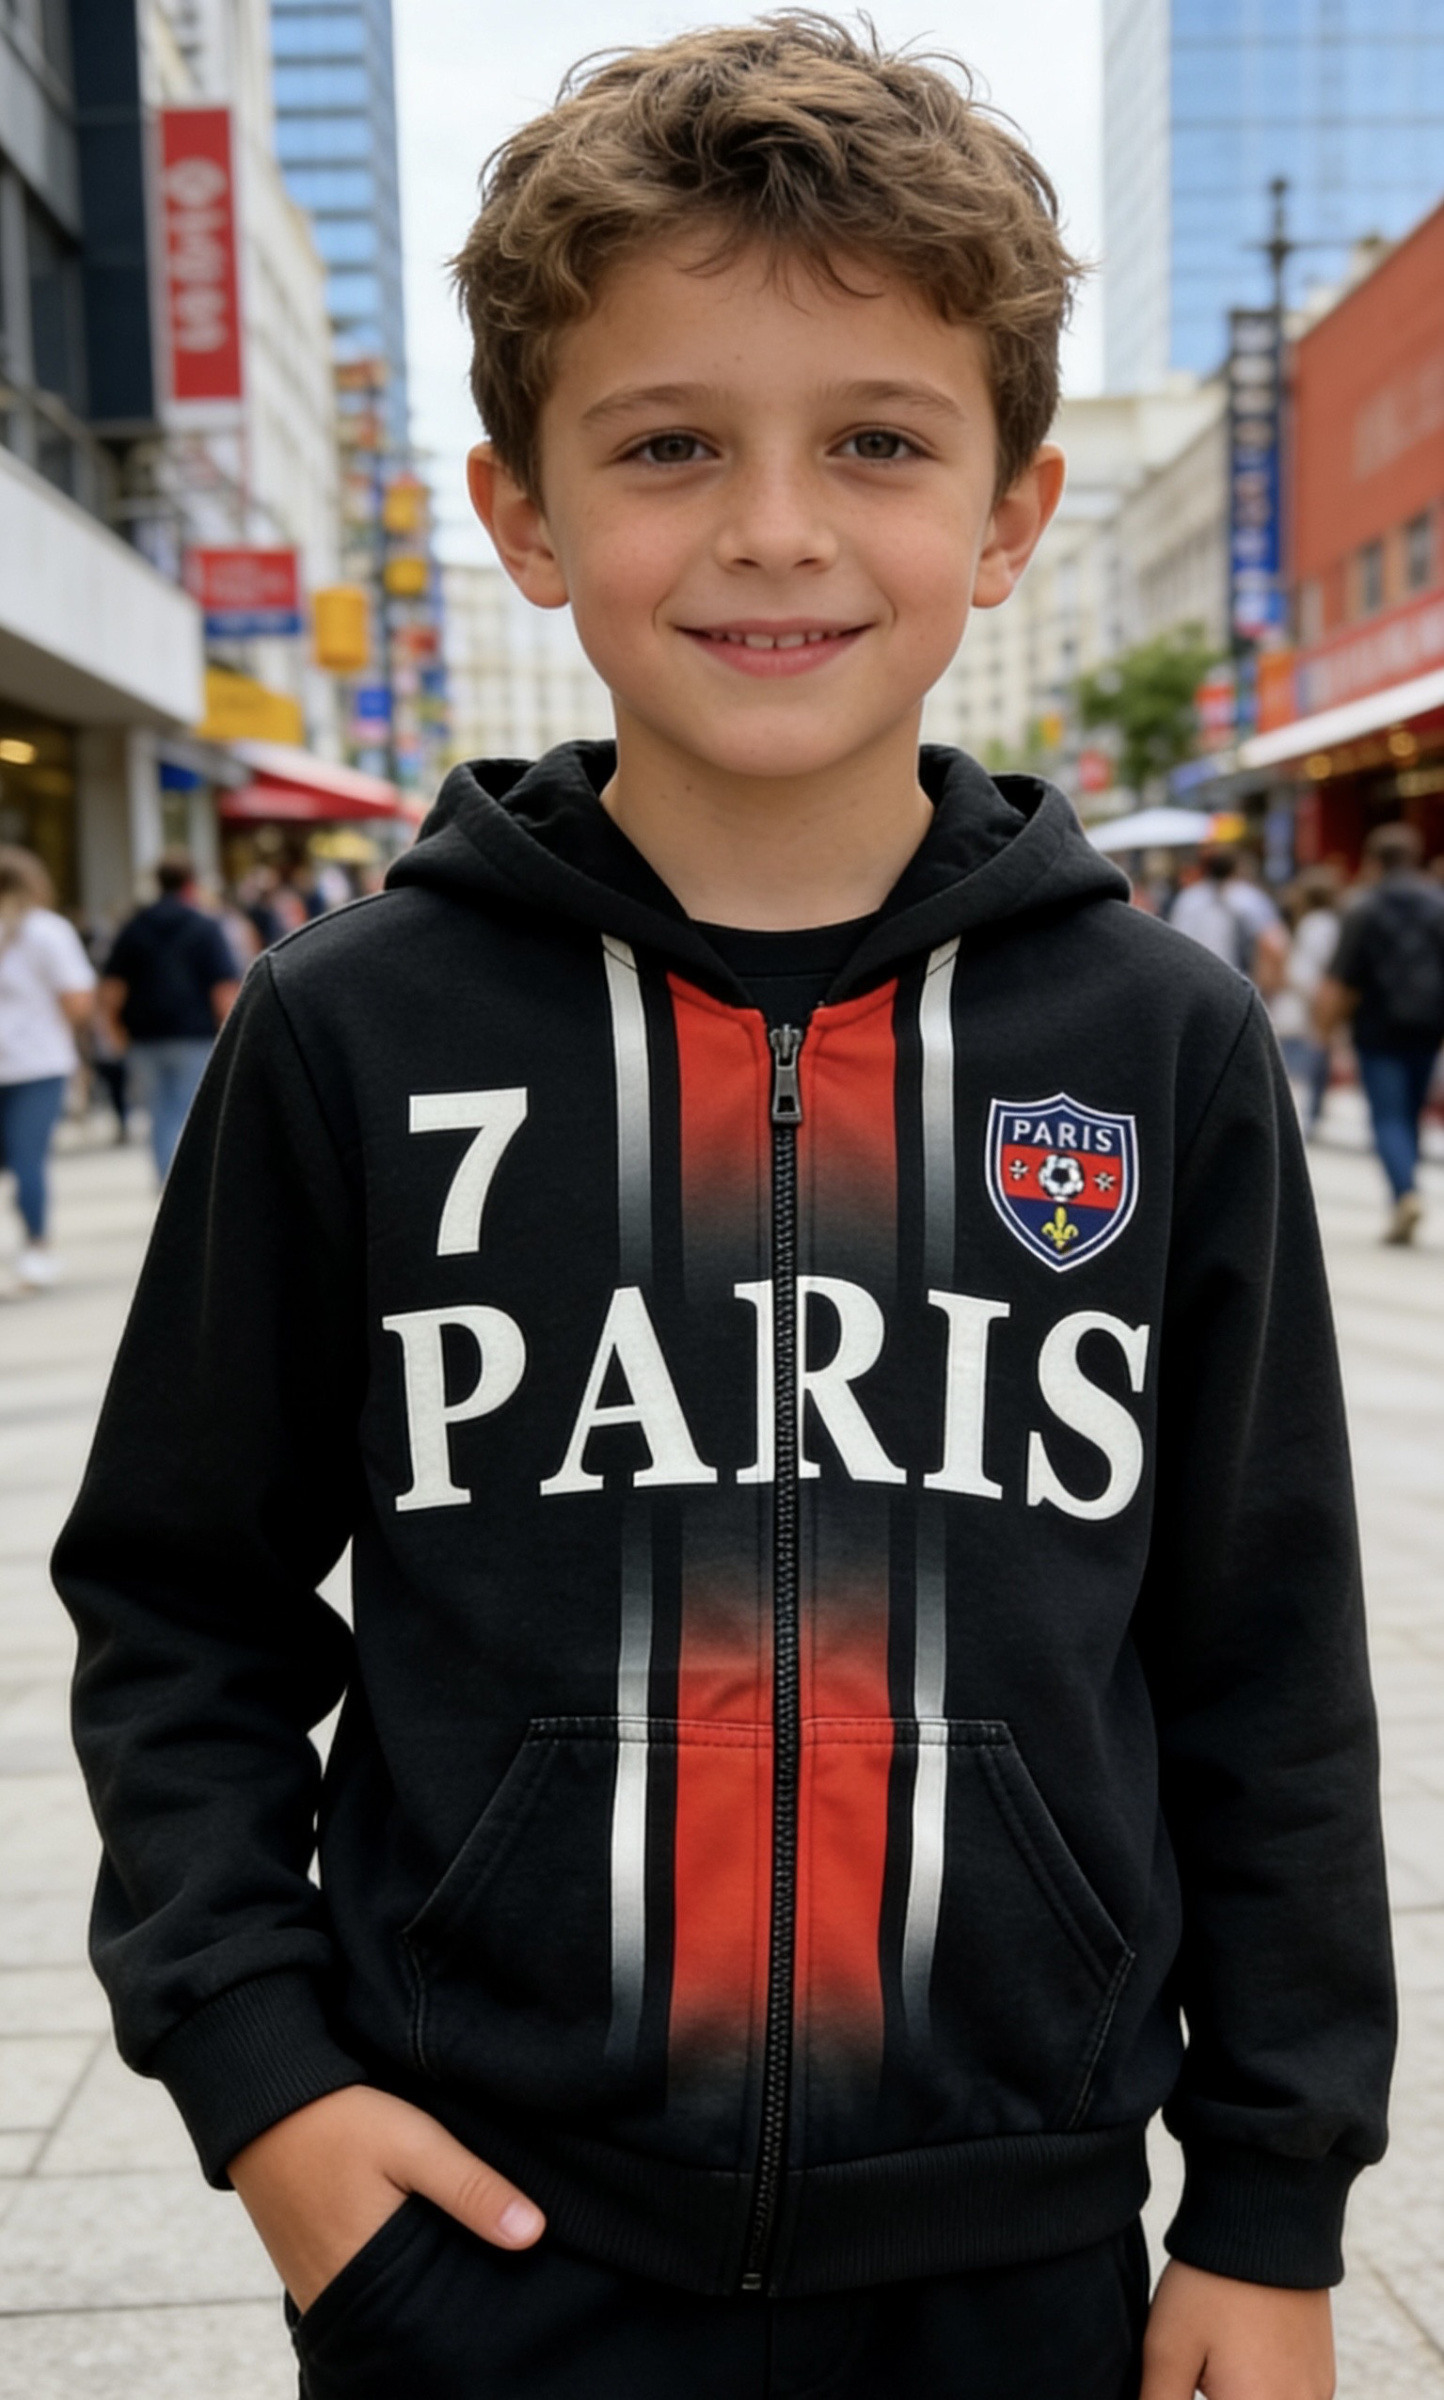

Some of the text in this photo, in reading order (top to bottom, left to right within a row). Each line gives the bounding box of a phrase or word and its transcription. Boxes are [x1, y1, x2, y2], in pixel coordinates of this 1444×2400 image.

[408, 1087, 528, 1256] 7
[1013, 1119, 1113, 1152] PARIS
[382, 1276, 1150, 1521] PARIS
